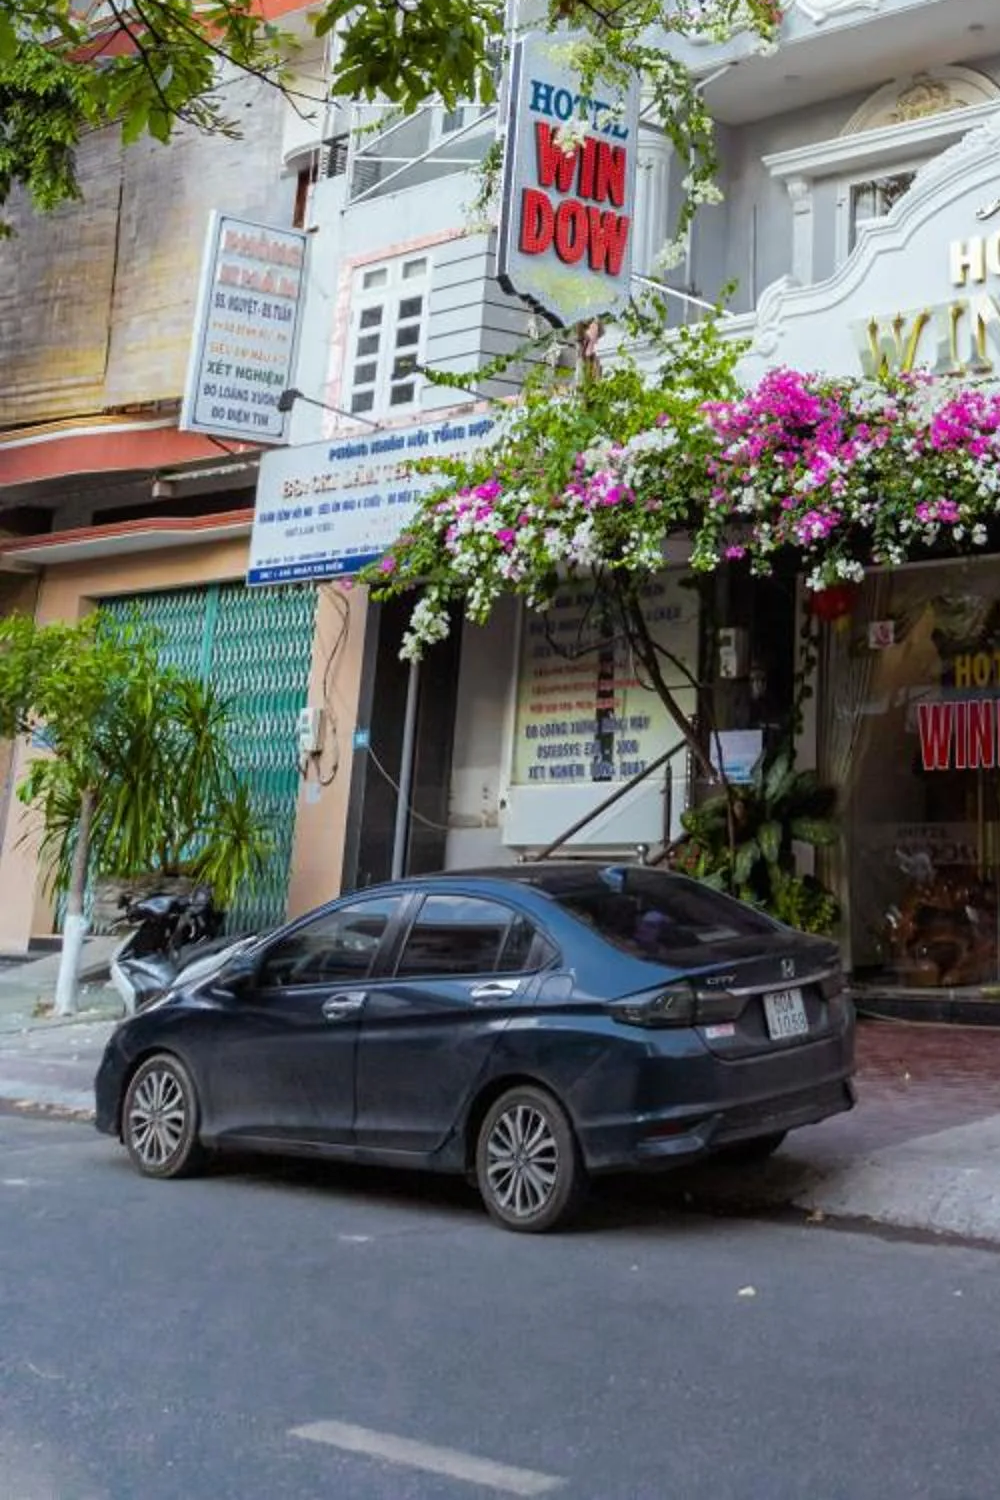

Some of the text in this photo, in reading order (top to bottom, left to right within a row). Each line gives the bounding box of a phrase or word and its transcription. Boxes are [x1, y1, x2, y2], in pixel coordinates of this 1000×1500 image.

[534, 119, 628, 207] WIN
[518, 187, 631, 277] DOW
[206, 360, 285, 390] XÉT NGHIỆM
[432, 420, 466, 444] TỔNG
